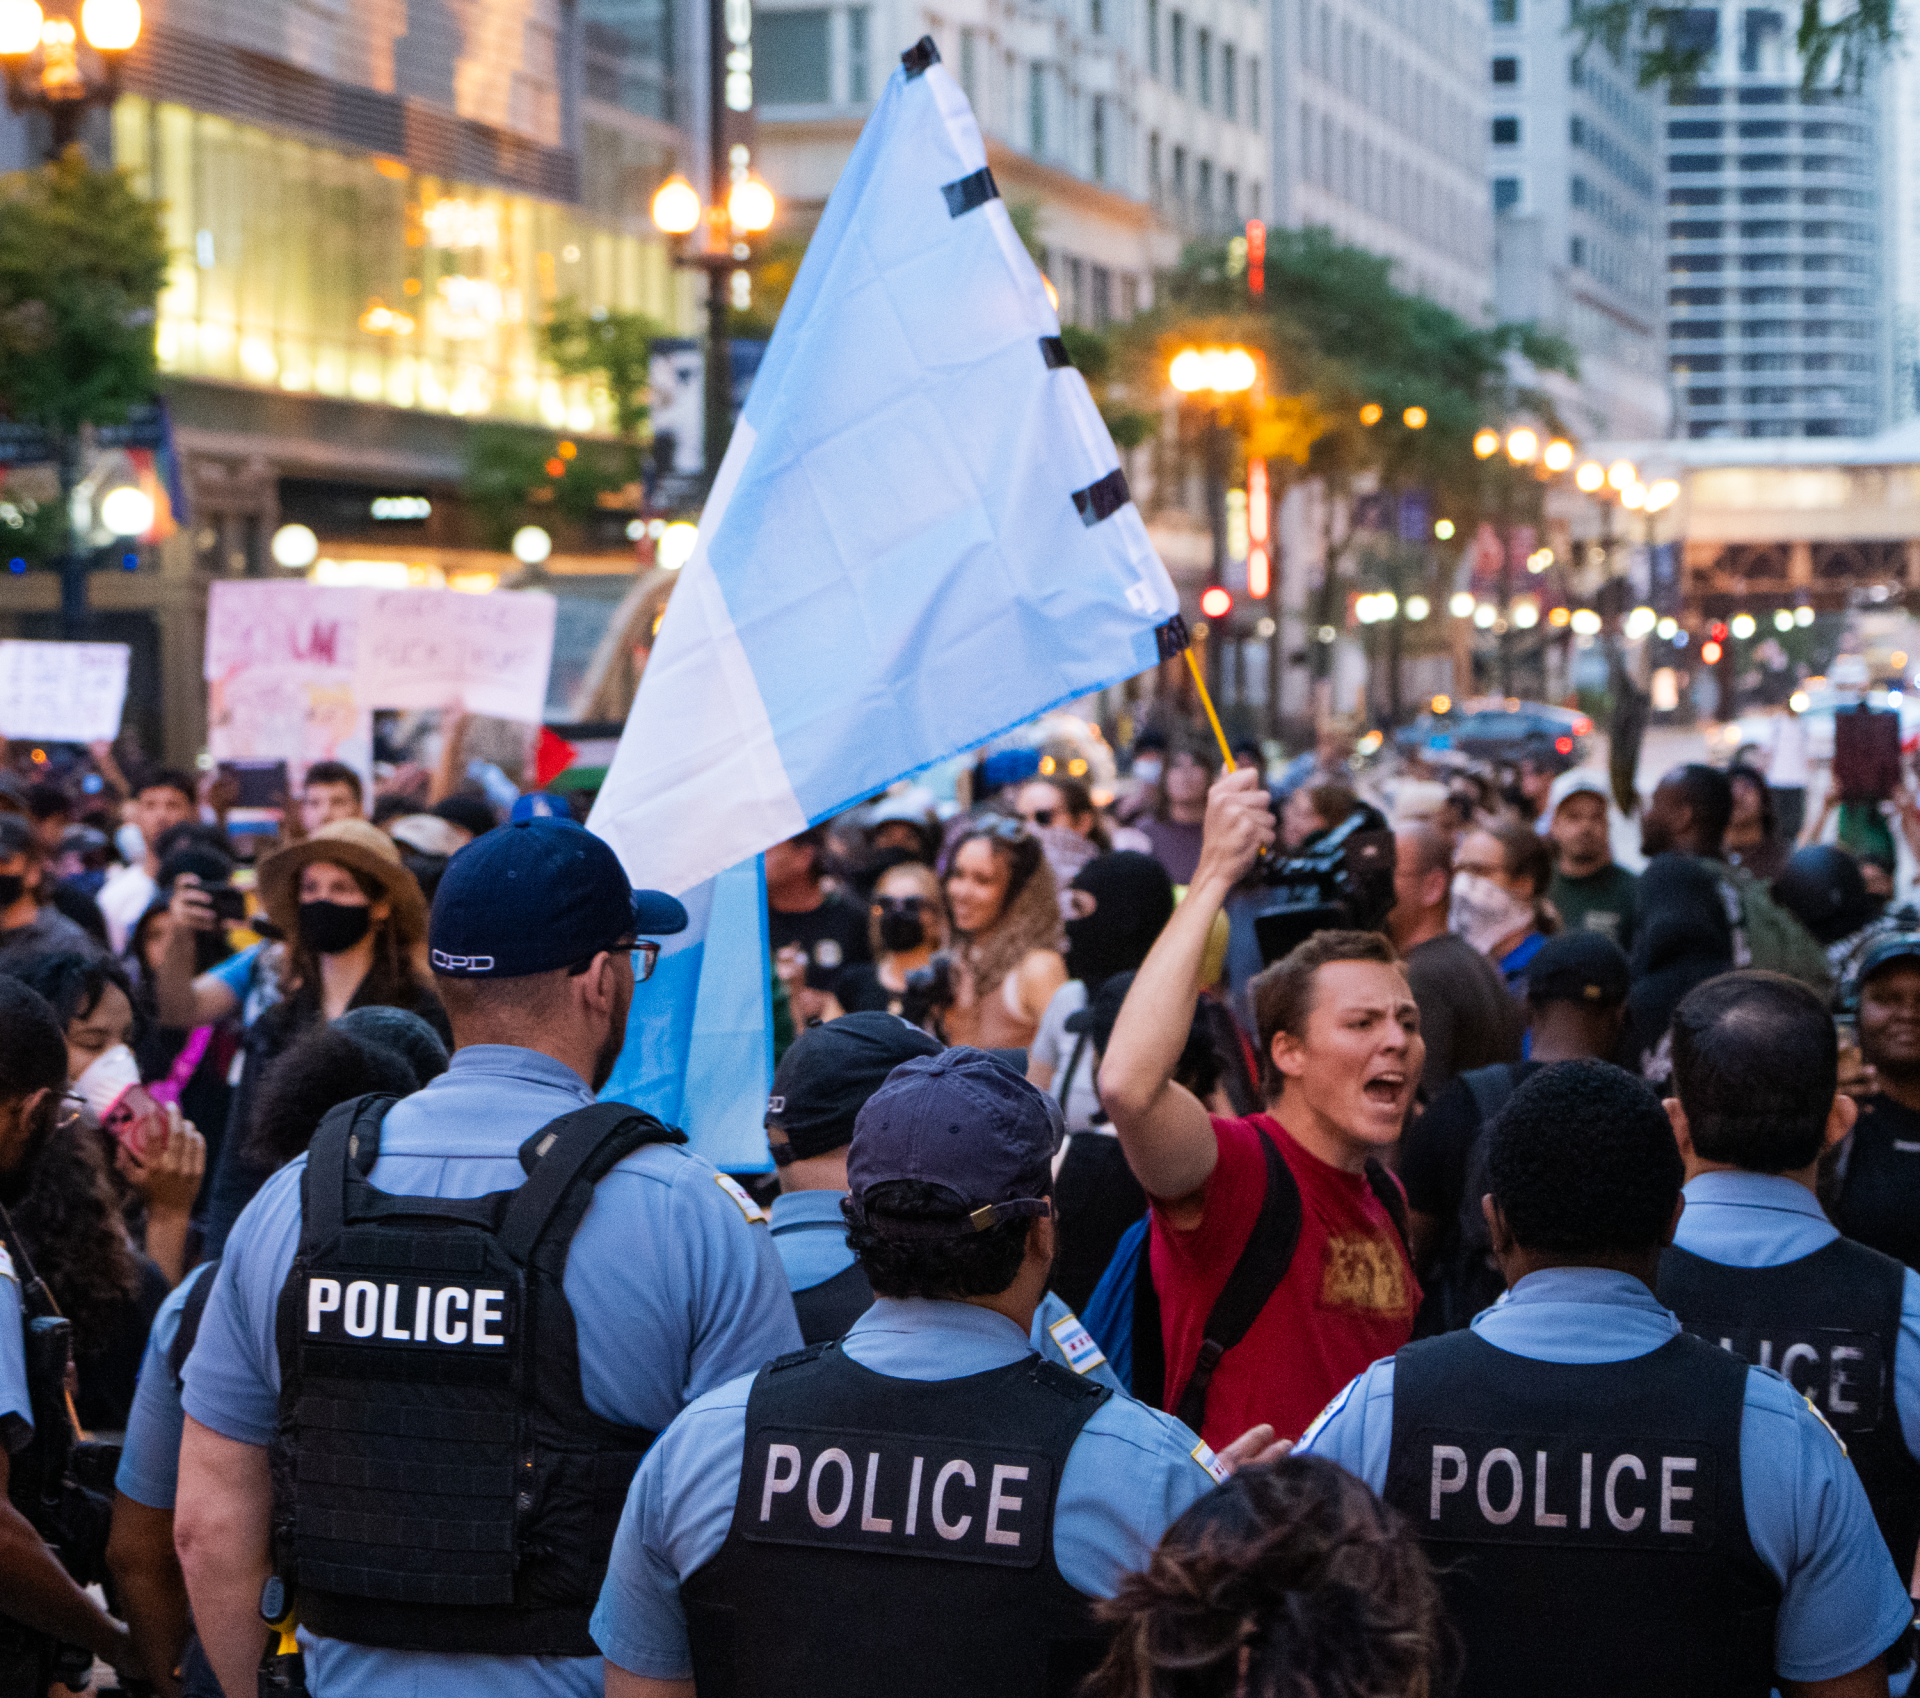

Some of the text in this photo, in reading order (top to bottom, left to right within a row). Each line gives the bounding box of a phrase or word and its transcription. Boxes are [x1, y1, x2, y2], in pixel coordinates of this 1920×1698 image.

[432, 948, 495, 971] CPD
[308, 1278, 505, 1345] POLICE
[760, 1443, 1029, 1546] POLICE
[1430, 1445, 1697, 1534] POLICE
